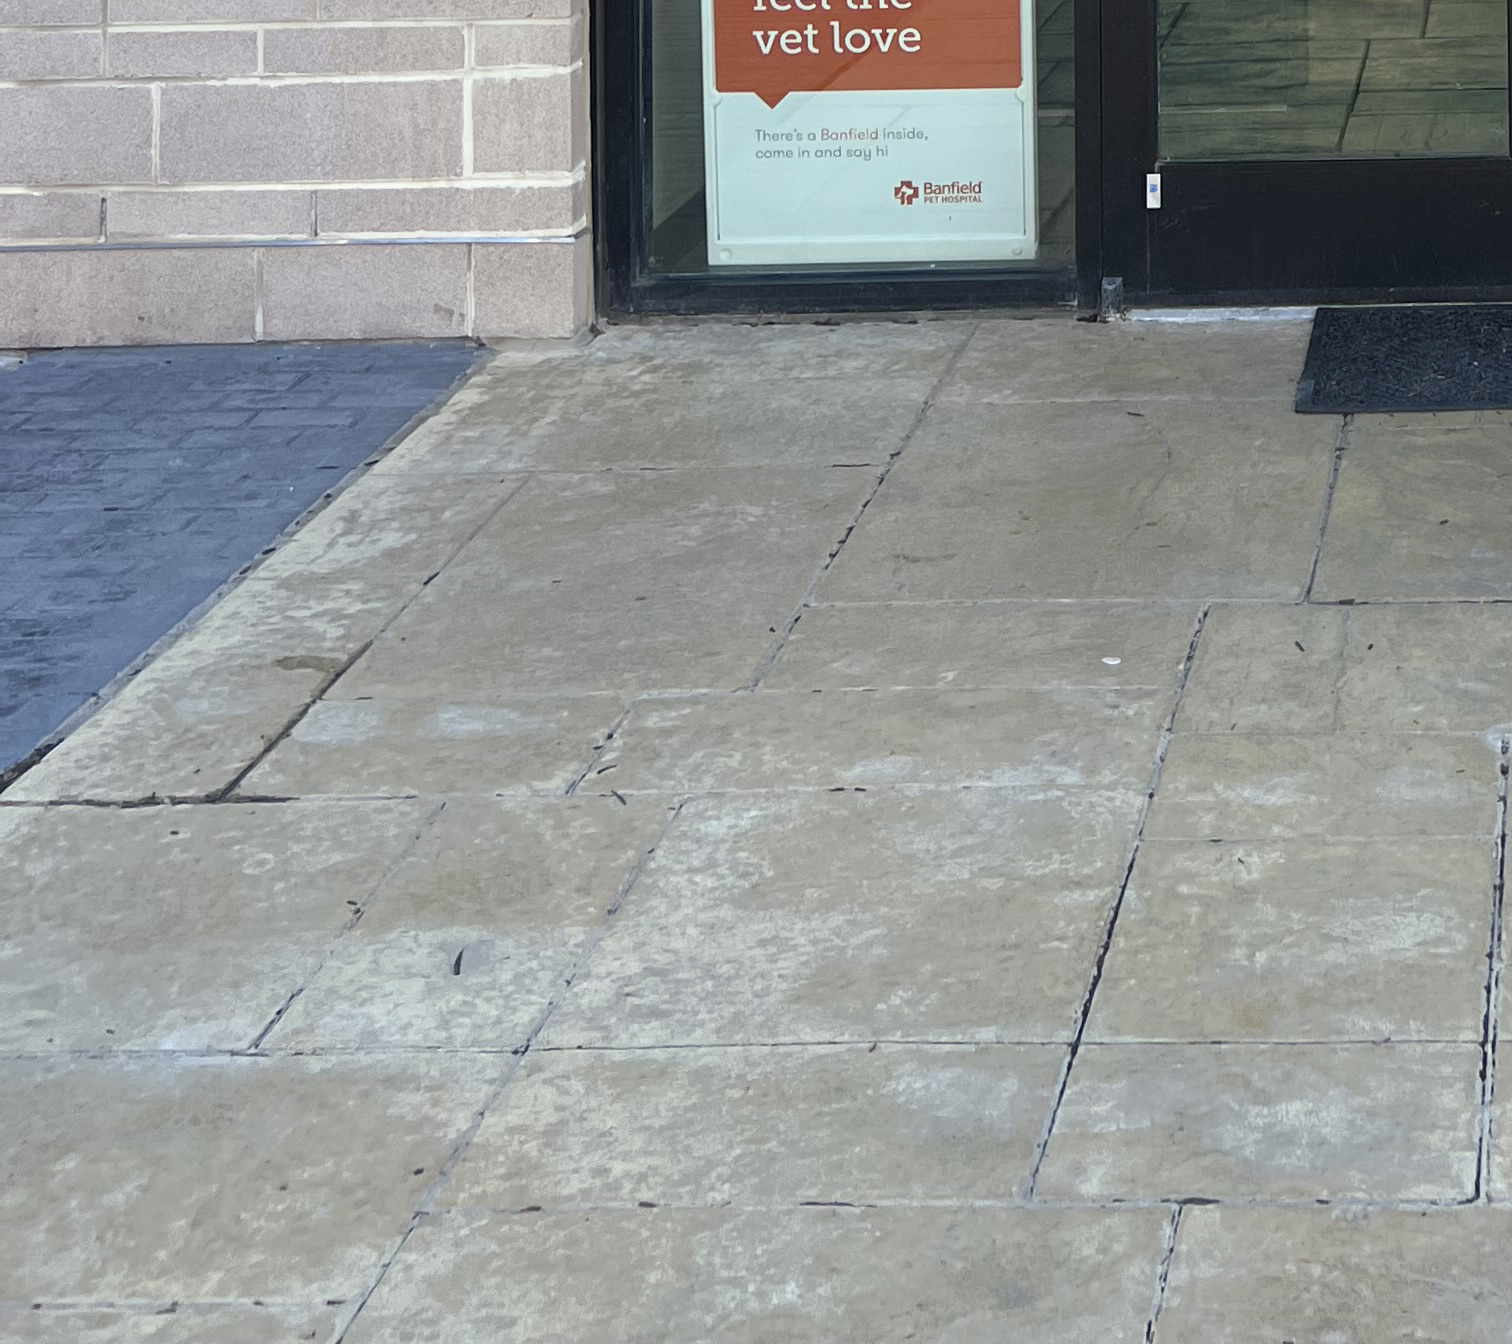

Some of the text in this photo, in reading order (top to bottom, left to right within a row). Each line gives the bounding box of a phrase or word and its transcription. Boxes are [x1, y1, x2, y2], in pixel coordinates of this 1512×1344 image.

[753, 20, 922, 54] vet love
[755, 127, 929, 142] There's a Banfield inside,
[756, 145, 889, 161] come in and say hi
[924, 181, 983, 194] Banfield
